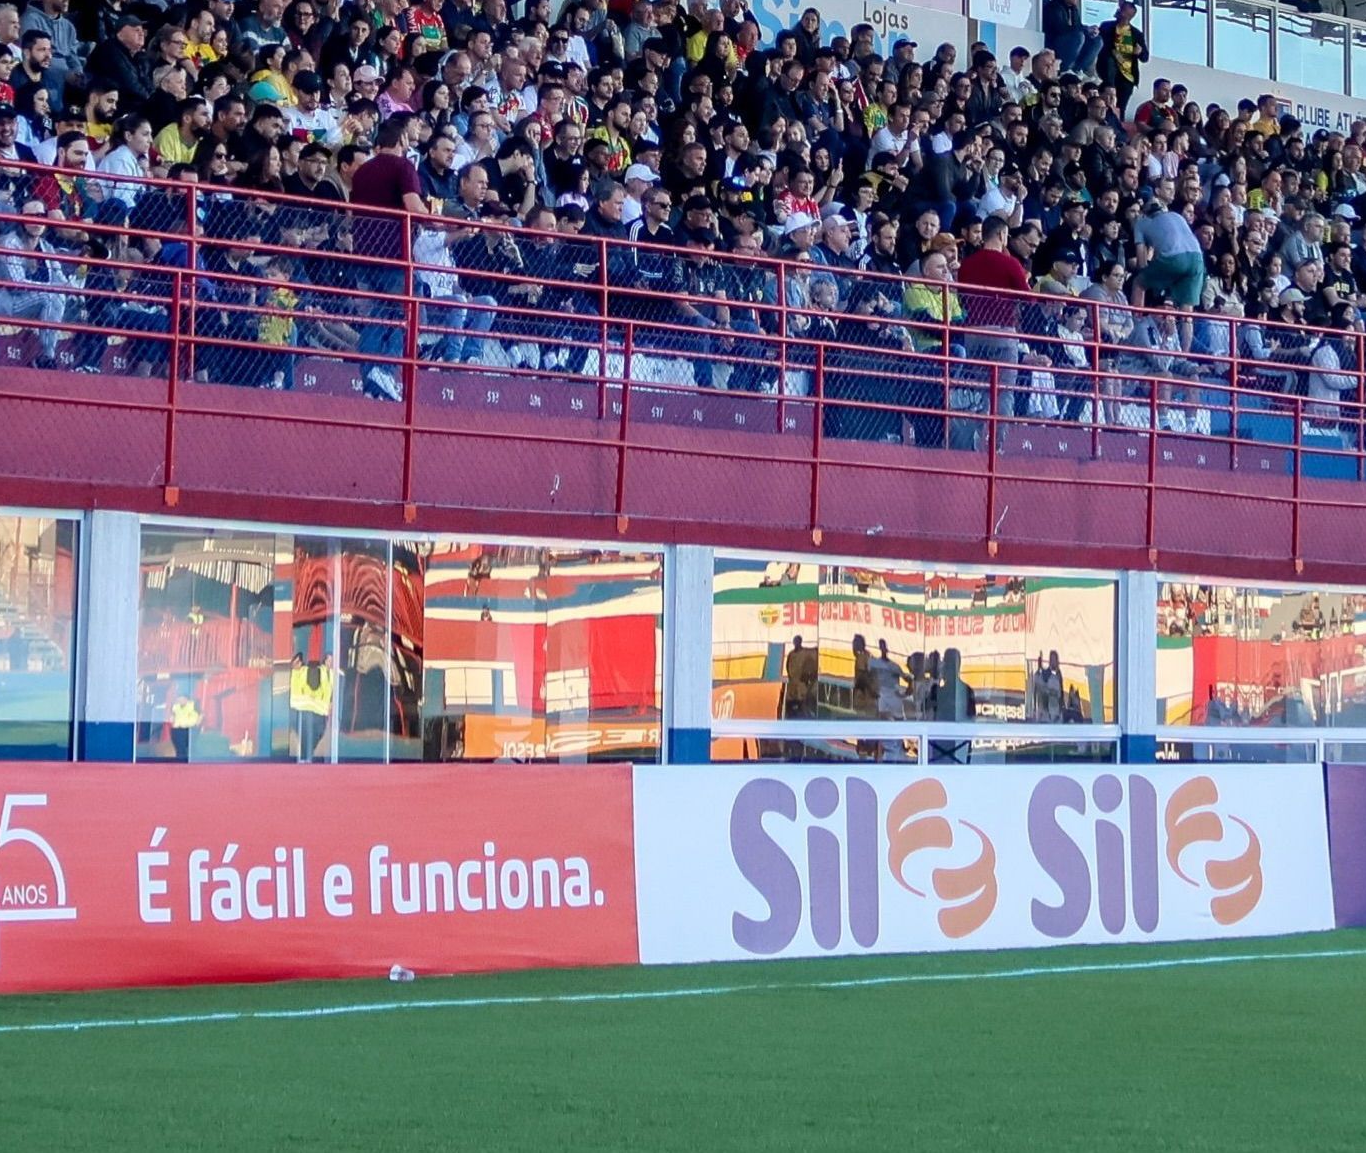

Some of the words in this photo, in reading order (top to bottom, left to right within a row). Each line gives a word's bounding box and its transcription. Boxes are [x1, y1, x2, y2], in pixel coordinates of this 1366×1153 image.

[864, 0, 909, 38] Lojas
[1297, 104, 1330, 128] CLUBE
[137, 826, 172, 923] É
[190, 844, 306, 924] fácil
[323, 864, 354, 918] e
[369, 840, 605, 916] funciona.
[730, 775, 879, 954] Sil
[1027, 773, 1159, 939] Sil
[1, 884, 48, 907] ANOS
